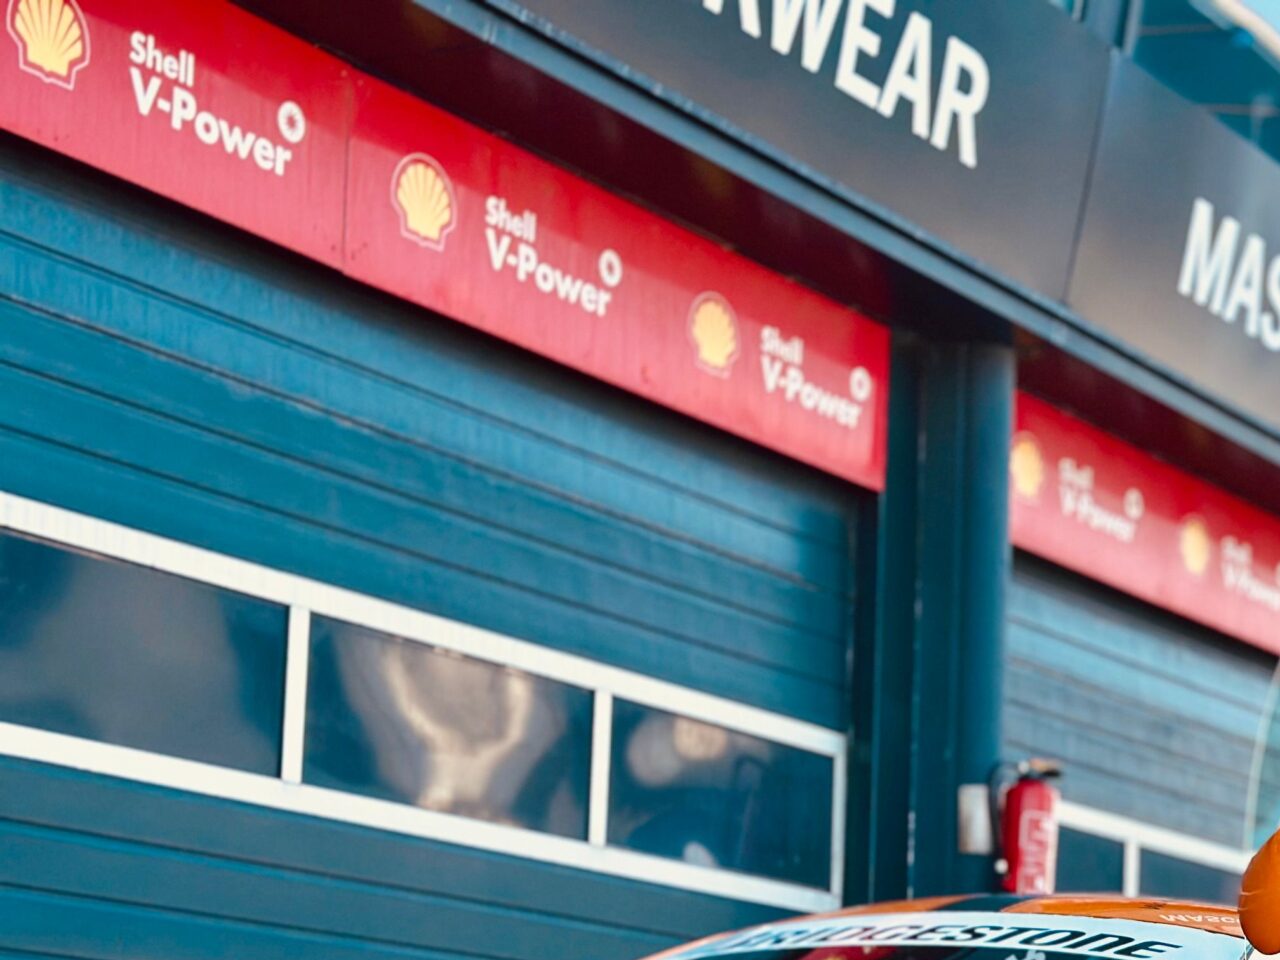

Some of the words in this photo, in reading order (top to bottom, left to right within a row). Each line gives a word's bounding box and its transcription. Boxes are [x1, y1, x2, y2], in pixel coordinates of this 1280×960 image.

[129, 30, 195, 88] Shell
[702, 0, 990, 169] WEAR
[130, 66, 292, 176] V-Power
[485, 195, 537, 243] Shell
[485, 226, 611, 317] V-Power
[760, 353, 861, 429] V-Power
